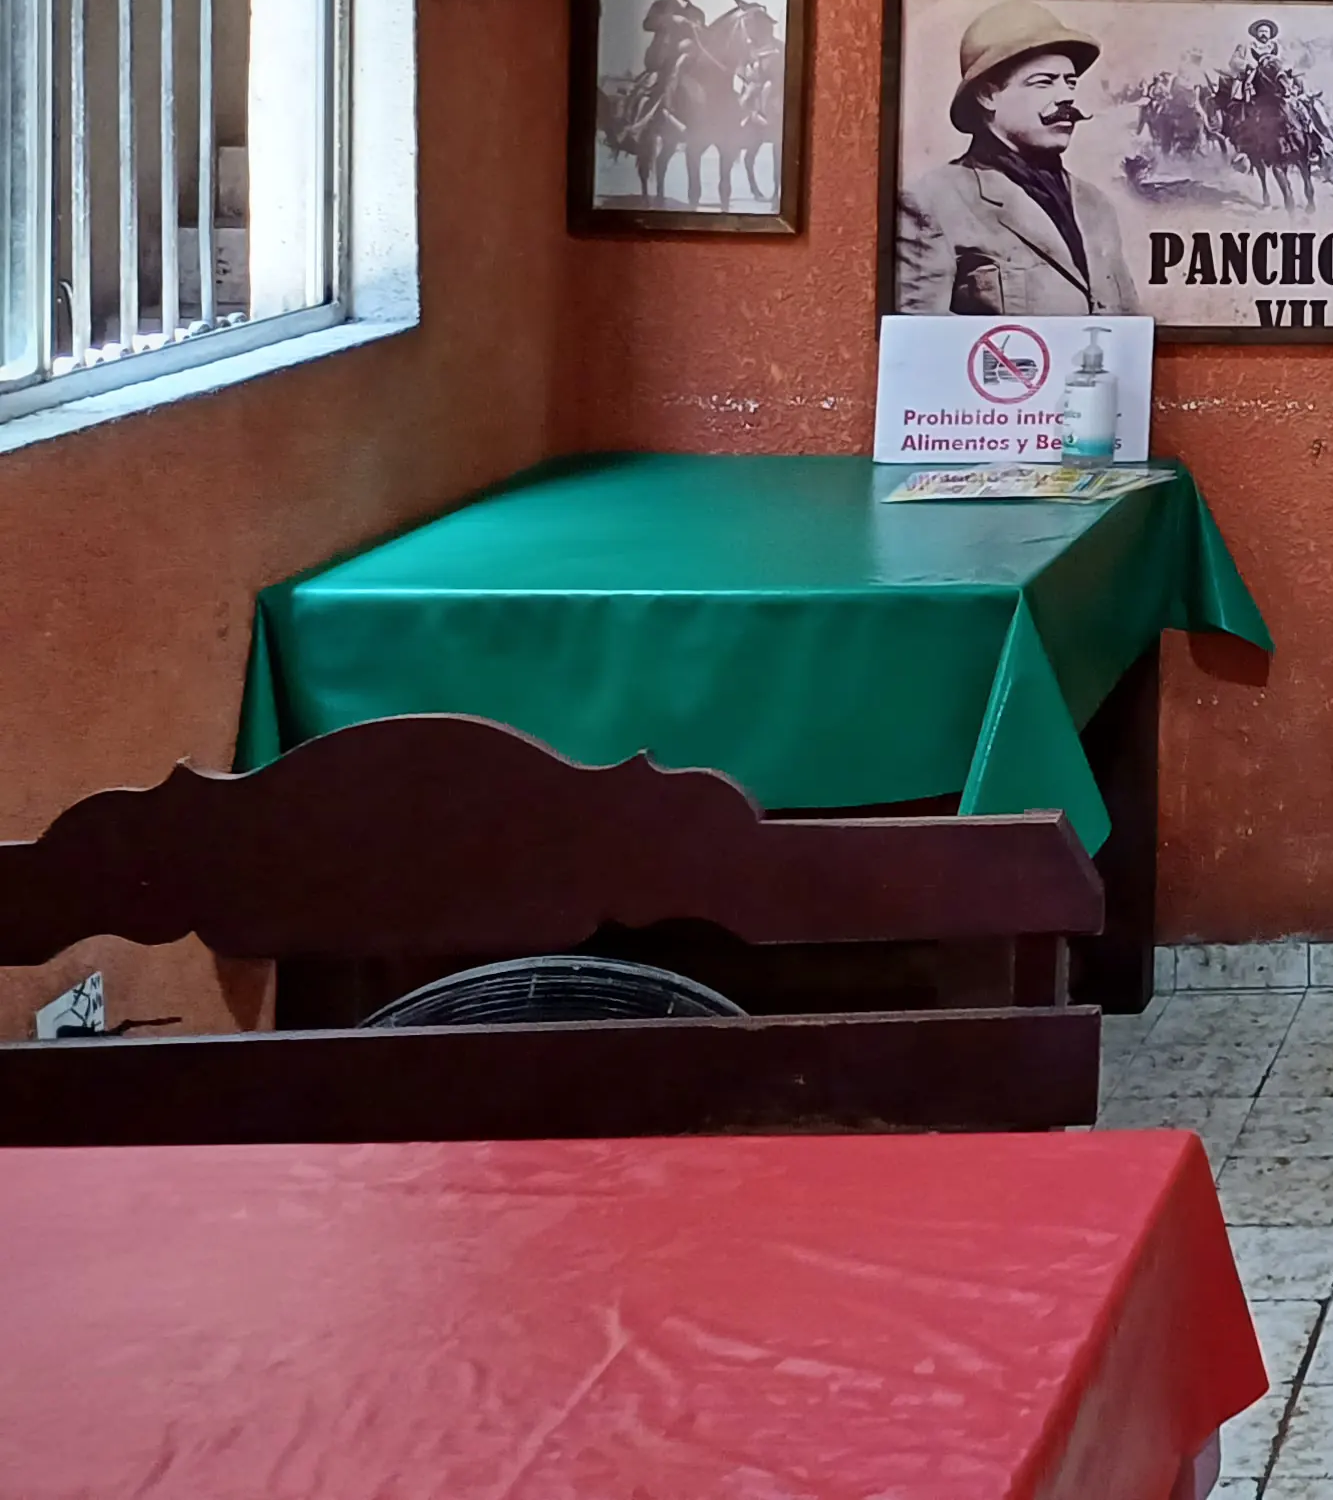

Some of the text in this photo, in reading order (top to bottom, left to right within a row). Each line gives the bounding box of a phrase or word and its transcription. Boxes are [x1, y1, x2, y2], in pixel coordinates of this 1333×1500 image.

[903, 409, 1009, 426] Prohibido
[901, 434, 1010, 452] Alimentos
[1016, 438, 1028, 454] y
